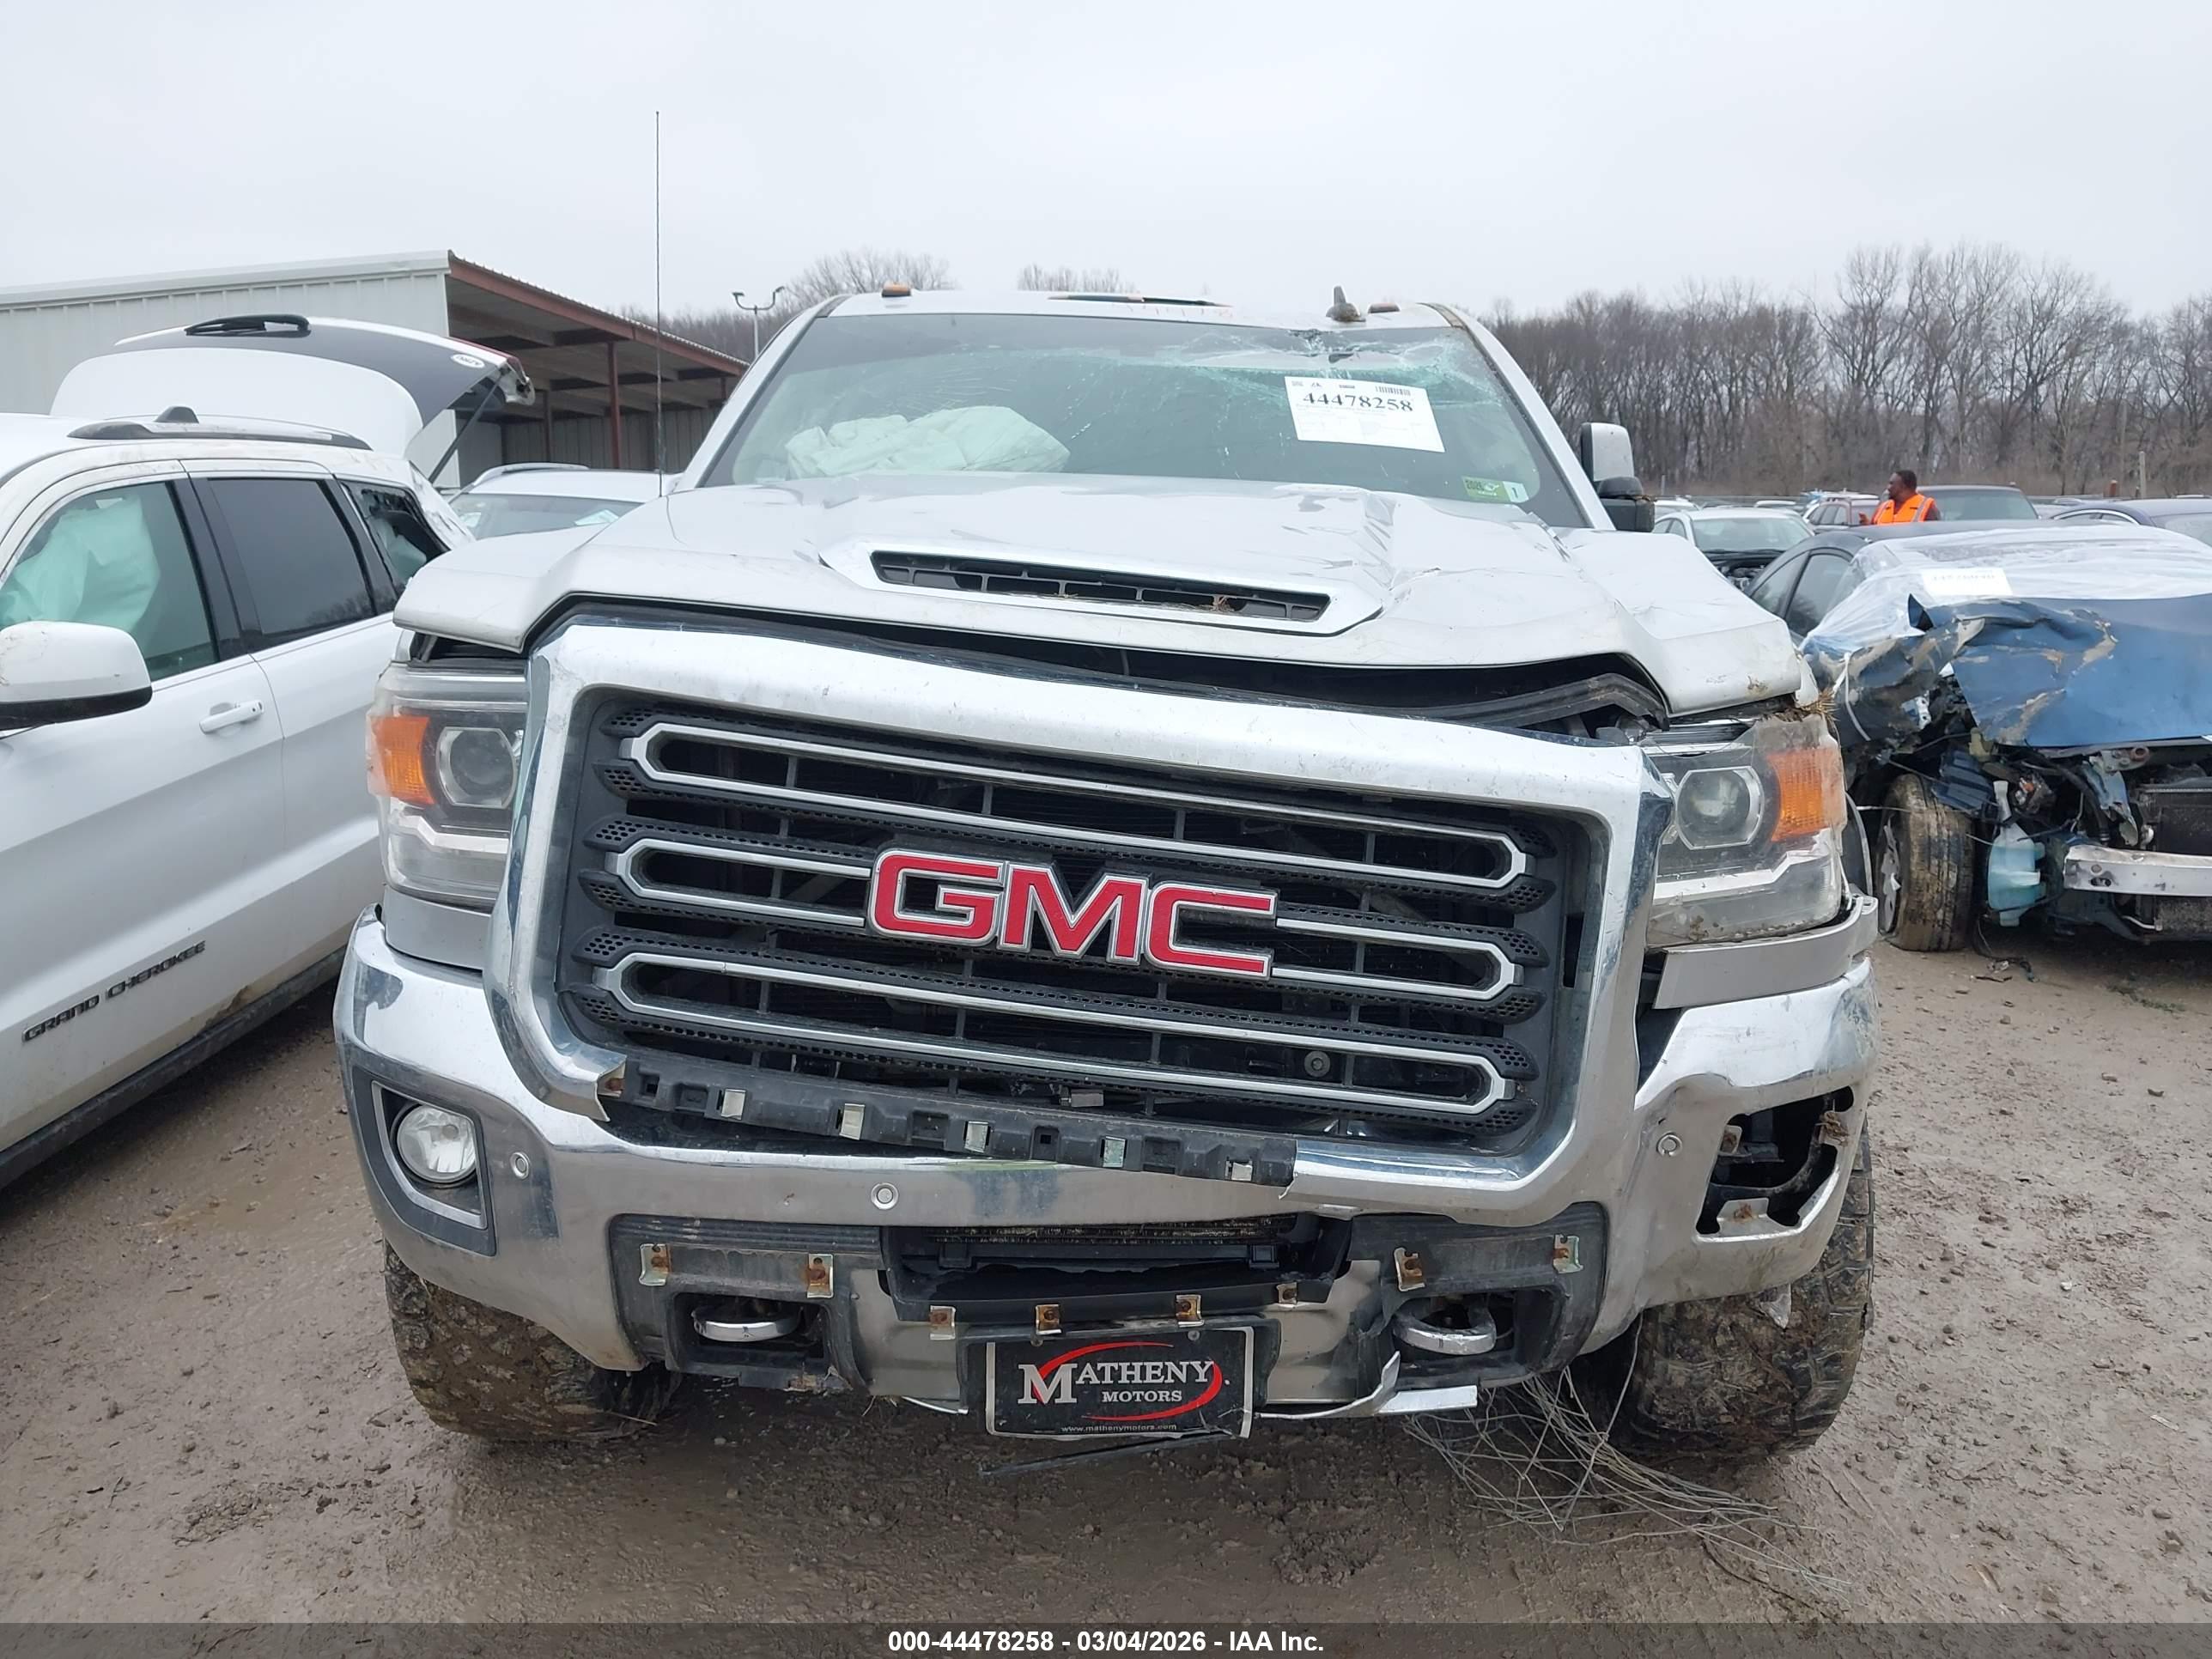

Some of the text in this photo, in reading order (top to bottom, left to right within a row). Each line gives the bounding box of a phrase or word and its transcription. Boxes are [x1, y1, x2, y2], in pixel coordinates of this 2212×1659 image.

[1303, 392, 1413, 412] 44478258
[871, 848, 1277, 980] GMC
[22, 940, 205, 1042] GRAND CHEROKEE
[1018, 1360, 1215, 1405] MATHENY
[1102, 1389, 1182, 1402] MOTORS
[1060, 1423, 1177, 1432] www.mathenymotors.com
